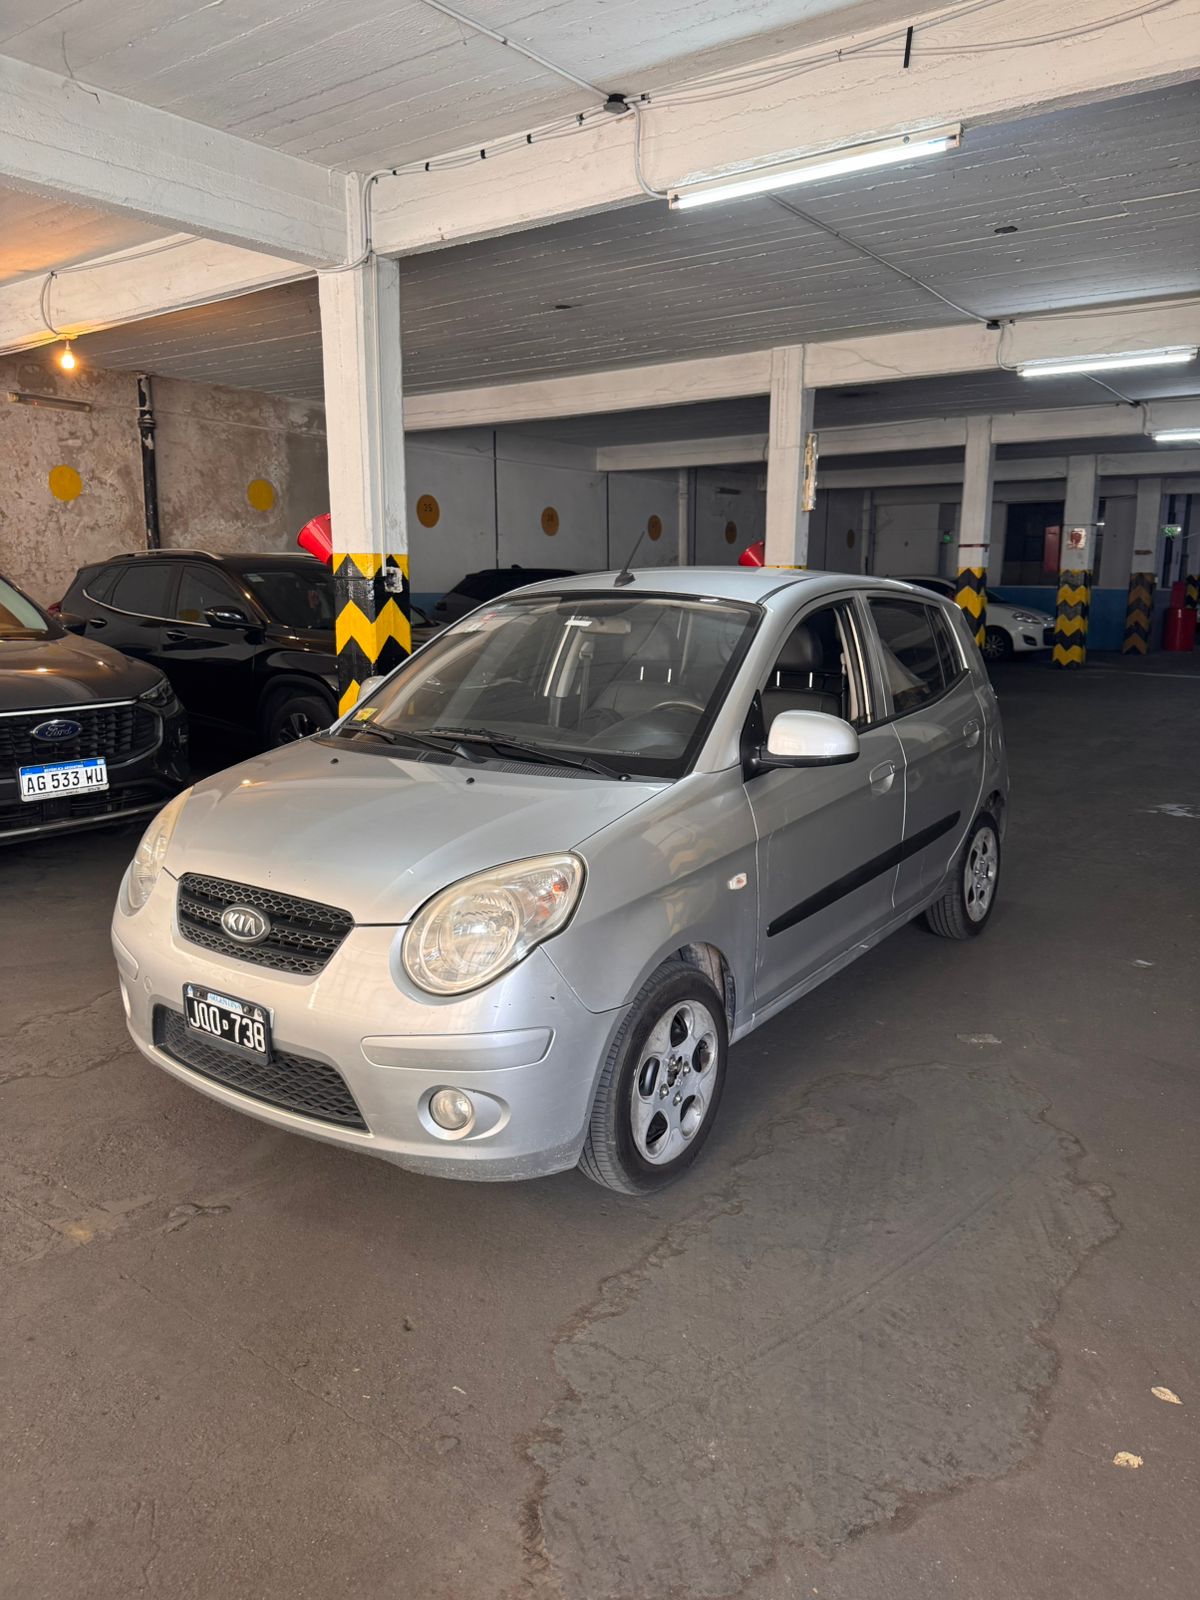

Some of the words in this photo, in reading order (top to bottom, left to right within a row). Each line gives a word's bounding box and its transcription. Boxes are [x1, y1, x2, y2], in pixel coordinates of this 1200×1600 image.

[45, 723, 72, 737] Ford
[27, 775, 46, 793] AG
[51, 771, 80, 789] 533
[85, 767, 103, 785] WU
[227, 911, 256, 936] KIA
[230, 1013, 266, 1053] 738
